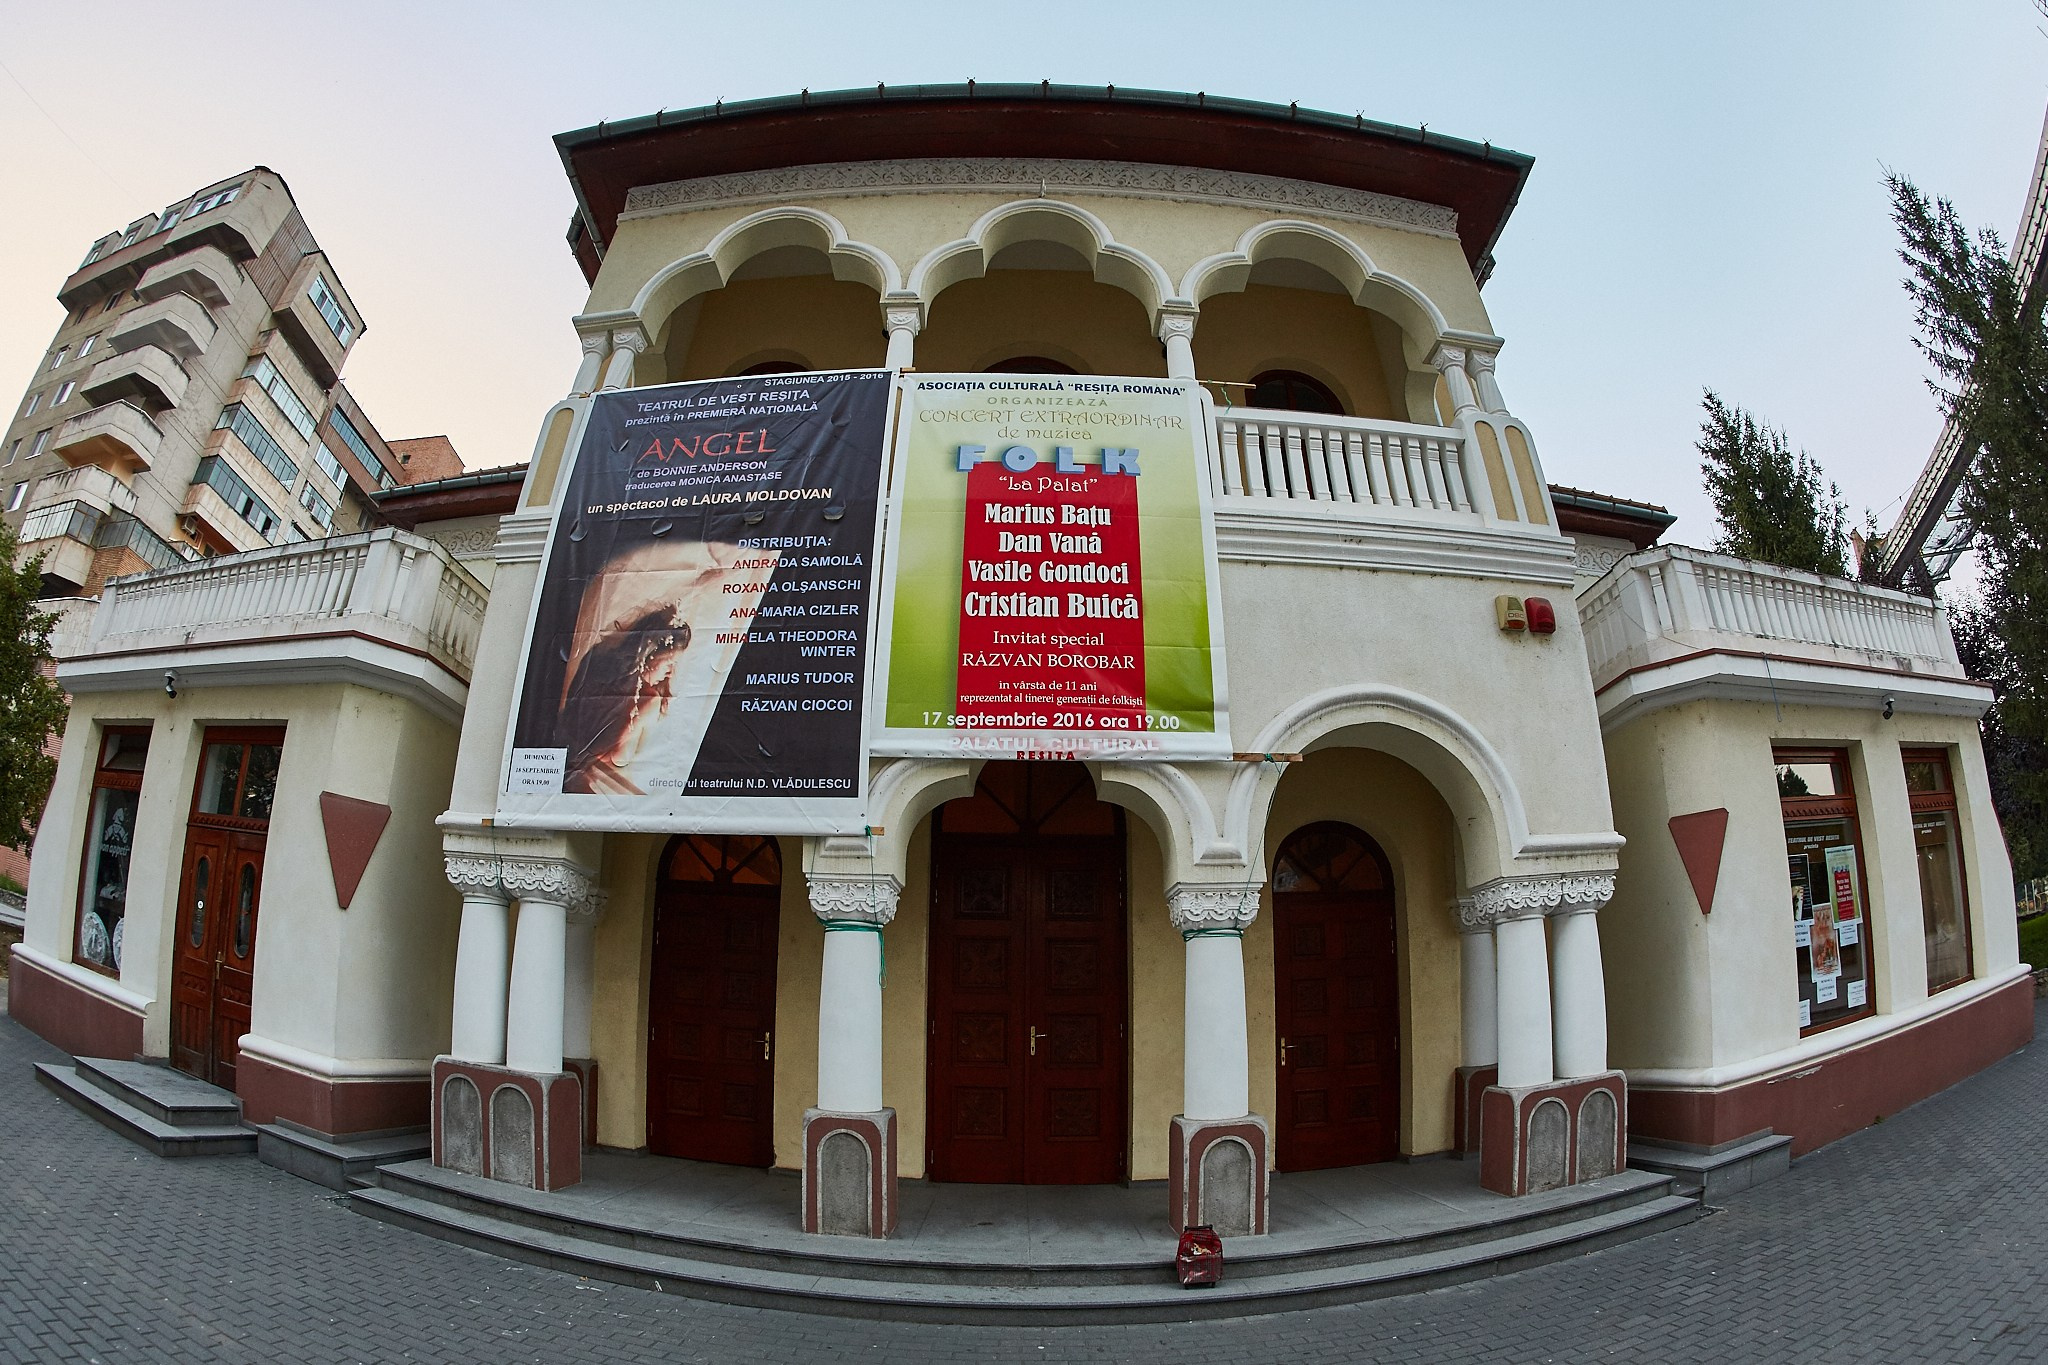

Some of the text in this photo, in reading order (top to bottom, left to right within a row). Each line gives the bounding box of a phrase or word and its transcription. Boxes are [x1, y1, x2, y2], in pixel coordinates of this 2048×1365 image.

[764, 376, 825, 387] STAGIUNEA
[826, 374, 851, 383] 2015
[859, 372, 884, 380] 2016
[637, 398, 696, 413] TEATRUL
[698, 396, 718, 407] DE
[720, 392, 757, 404] VEST
[625, 413, 670, 427] prezintă
[673, 413, 684, 422] în
[687, 405, 747, 419] PREMIERĂ
[919, 409, 1184, 430] CONCERT EXTRAORDINAR
[998, 426, 1019, 439] de
[637, 429, 777, 463] ANGEL
[956, 444, 1141, 476] FOLK
[636, 460, 767, 479] de BONNIE ANDERSON
[624, 471, 782, 491] traducerea MONICA ANASTASE
[587, 487, 832, 514] un spectacol de LAURA MOLDOVAN
[984, 503, 1055, 524] Marius
[999, 531, 1102, 554] Dan Vană
[732, 553, 863, 570] ANDRADA SAMOILĂ
[968, 560, 1129, 584] Vasile Gondoci
[722, 581, 778, 594] ROXANA
[729, 605, 859, 618] ANA-MARIA CIZLER
[965, 591, 1139, 619] Cristian Buică
[715, 630, 857, 644] MIHAELA THEODORA
[993, 630, 1105, 648] Invitat special
[801, 646, 856, 657] WINTER
[962, 651, 1135, 669] RĂZVAN BOROBAR
[746, 672, 854, 685] MARIUS TUDOR
[1049, 681, 1062, 690] de
[1065, 682, 1076, 691] 11
[1080, 682, 1097, 691] ani
[741, 698, 852, 712] RĂZVAN CIOCOI
[960, 693, 1012, 705] reprezentat
[1014, 693, 1023, 703] al
[1025, 694, 1054, 703] tinerei
[1098, 695, 1110, 705] de
[922, 711, 1180, 730] 17 septembrie 2016 ora 19.00
[950, 736, 1160, 751] PALATUL CULTURAL
[649, 776, 851, 789] directorul teatrului N.D. VLĂDULESCU
